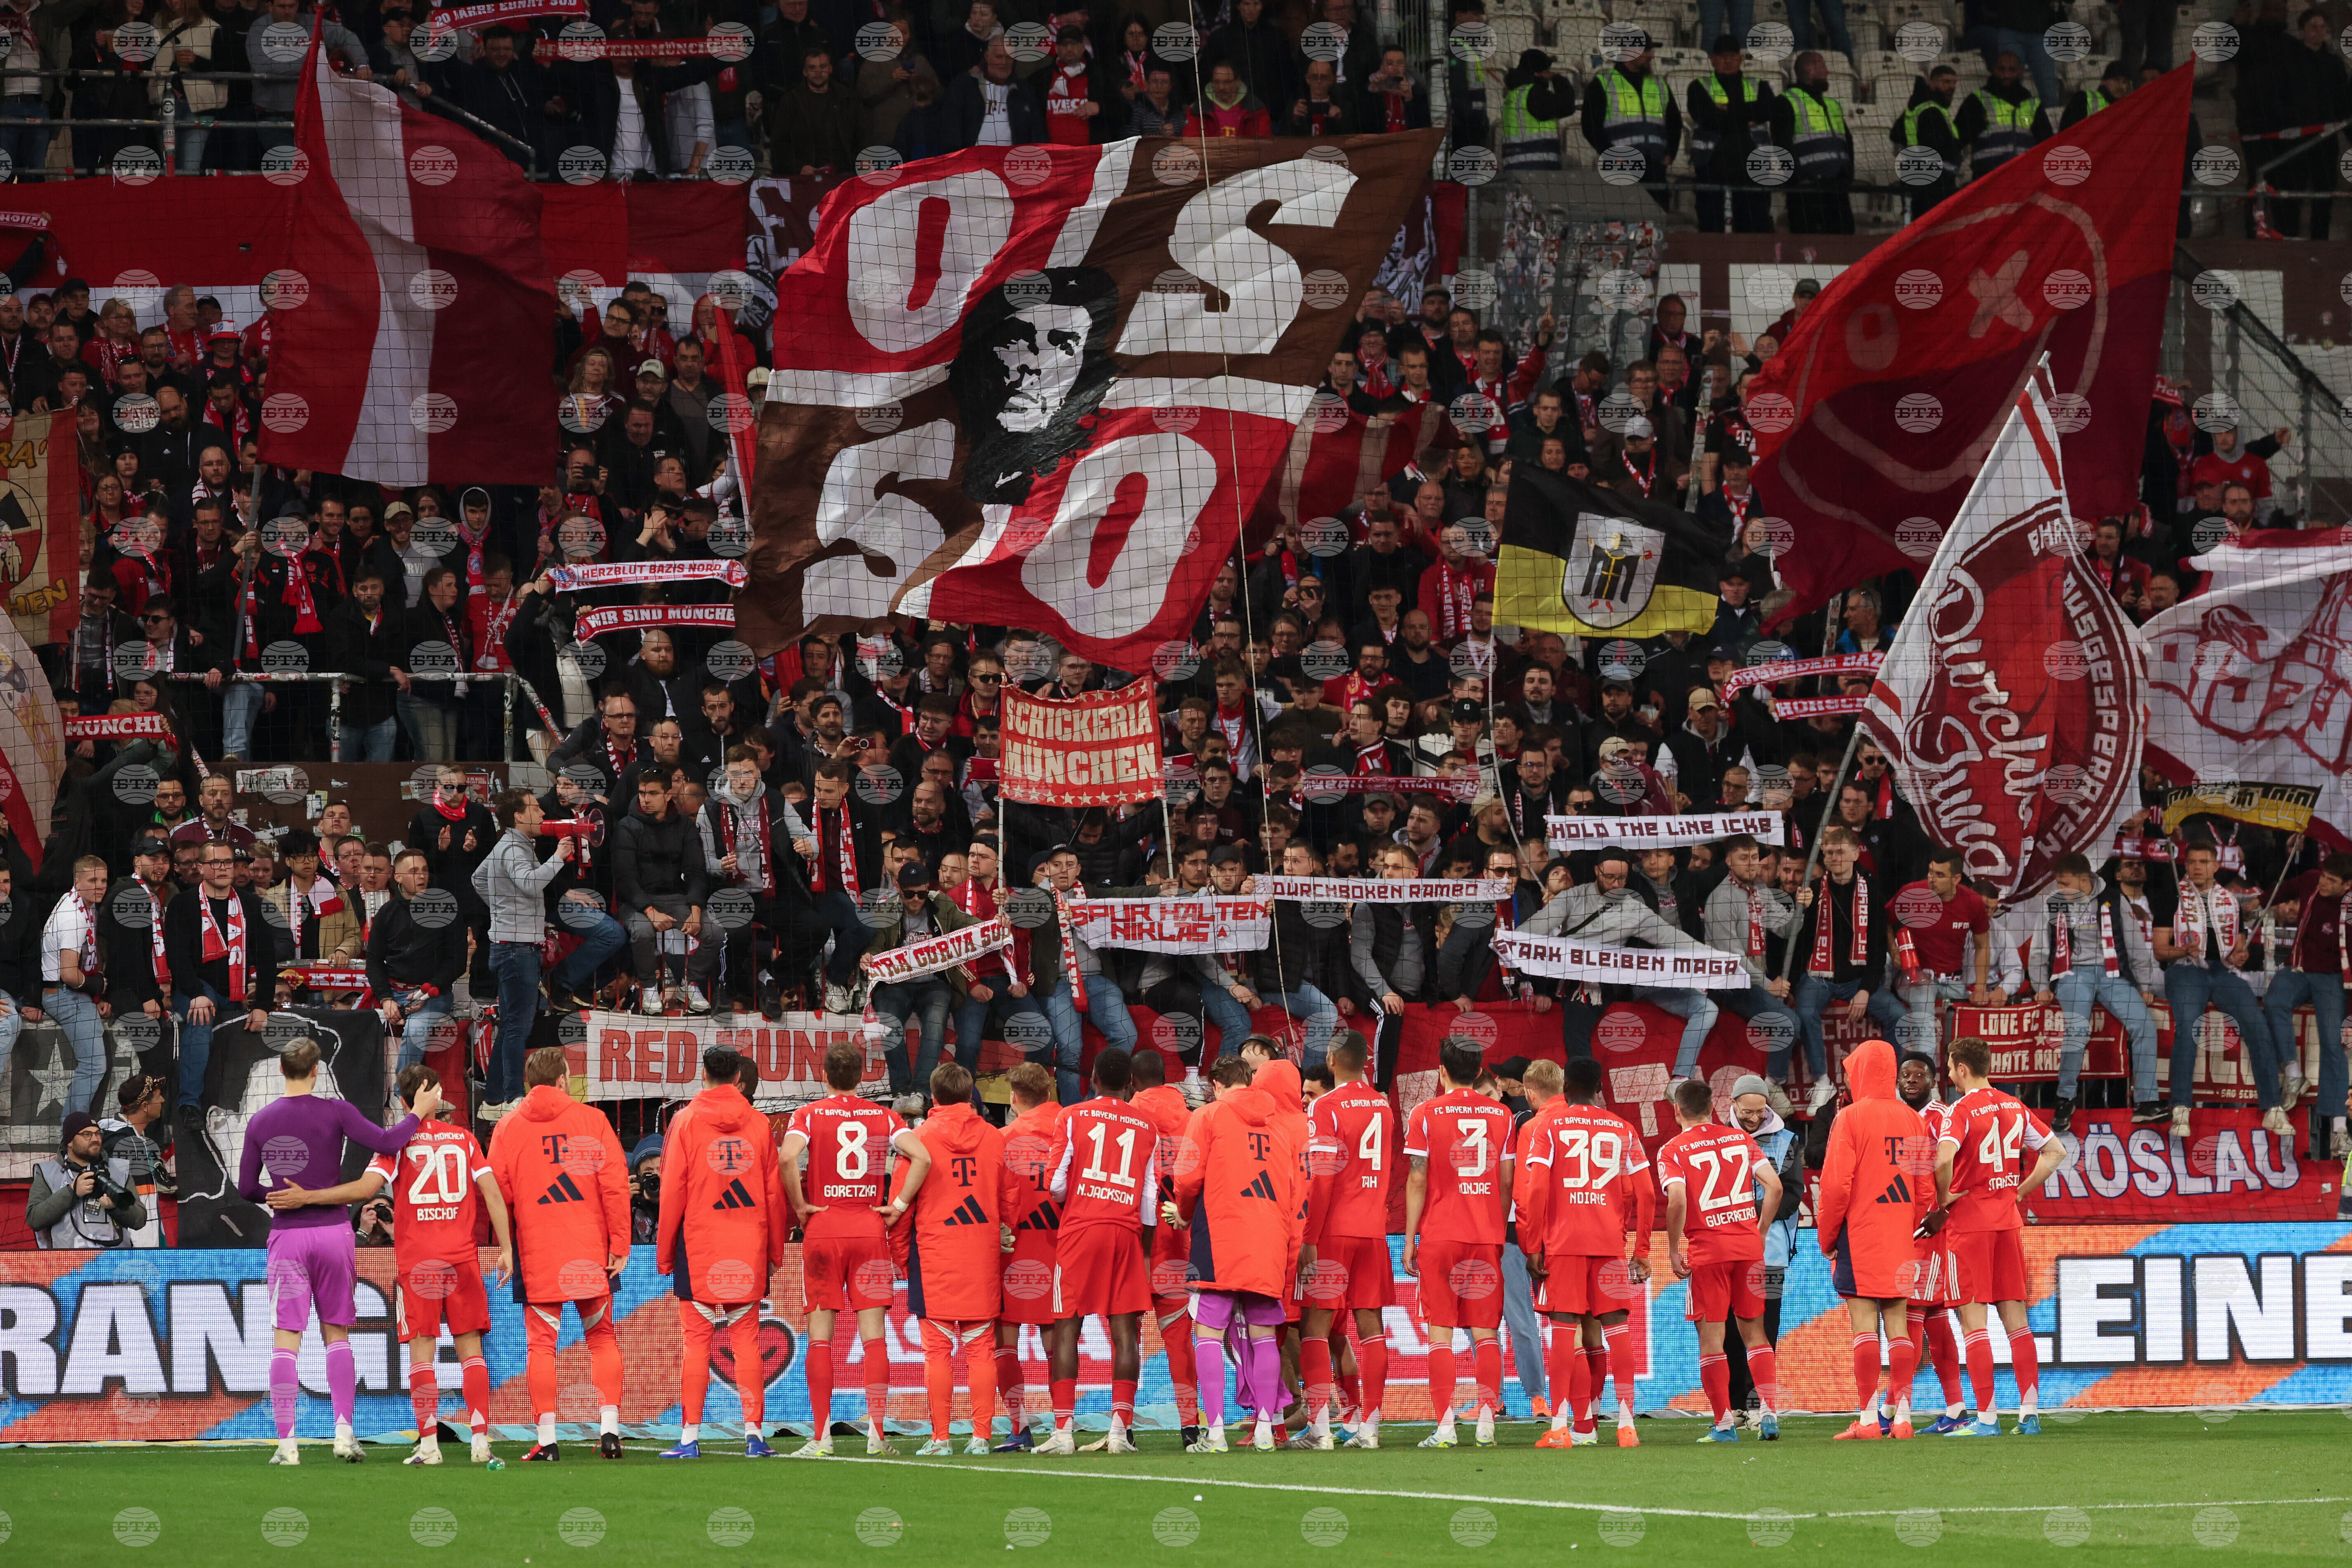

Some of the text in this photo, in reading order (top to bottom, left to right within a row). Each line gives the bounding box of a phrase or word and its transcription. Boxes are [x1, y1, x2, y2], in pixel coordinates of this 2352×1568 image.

[453, 4, 495, 21] JAHRE
[1046, 99, 1088, 111] IVEC
[582, 562, 721, 579] HERZBLUT BAZIS NORD
[585, 611, 619, 627] WIR
[623, 608, 663, 622] SIND
[1005, 696, 1153, 743] SCHICKERIA
[1003, 737, 1159, 785] MÜNCHEN
[1552, 818, 1771, 839] HOLD THE LINE ICKE
[1274, 881, 1478, 900] DURCHBOXEN RAMBO
[1071, 901, 1272, 926] SPUR HALTEN
[1111, 921, 1210, 942] NIKLAS
[913, 931, 977, 970] CURVA
[1494, 939, 1738, 975] STARK BLEIBEN MAGA
[1979, 1009, 2104, 1036] LOVE FC BAN
[599, 1029, 698, 1083] RED
[1990, 1050, 2030, 1073] HATE
[825, 1108, 851, 1118] BAYERN
[853, 1108, 883, 1117] MÜNCHEN
[1340, 1100, 1349, 1109] FC
[1350, 1099, 1371, 1108] BAYERN
[1445, 1106, 1472, 1115] BAYERN
[1474, 1106, 1504, 1117] MÜNCHEN
[1970, 1109, 1980, 1118] FC
[1980, 1105, 2000, 1116] BAYERN
[1091, 1109, 1118, 1122] BAYERN
[1119, 1115, 1149, 1130] MÜNCHEN
[1564, 1117, 1591, 1126] BAYERN
[1593, 1118, 1624, 1129] MÜNCHEN
[542, 1134, 569, 1164] T
[837, 1121, 868, 1179] 8
[1248, 1132, 1270, 1161] T
[1359, 1112, 1382, 1170] 4
[1457, 1118, 1487, 1177] 3
[1680, 1134, 1746, 1153] FC BAYERN MÜNCHEN
[1884, 1137, 1904, 1165] T
[1979, 1113, 2024, 1173] 44
[1081, 1121, 1136, 1188] 11
[1559, 1129, 1622, 1190] 39
[406, 1144, 467, 1205] 20
[952, 1157, 977, 1187] T
[1361, 1176, 1377, 1188] TAH
[1688, 1144, 1753, 1212] 22
[823, 1185, 877, 1198] GORETZKA
[1076, 1183, 1134, 1206] N.JACKSON
[1569, 1191, 1607, 1206] NDIAYE
[417, 1207, 459, 1221] BISCHOF
[1705, 1205, 1757, 1228] GUERREIRO
